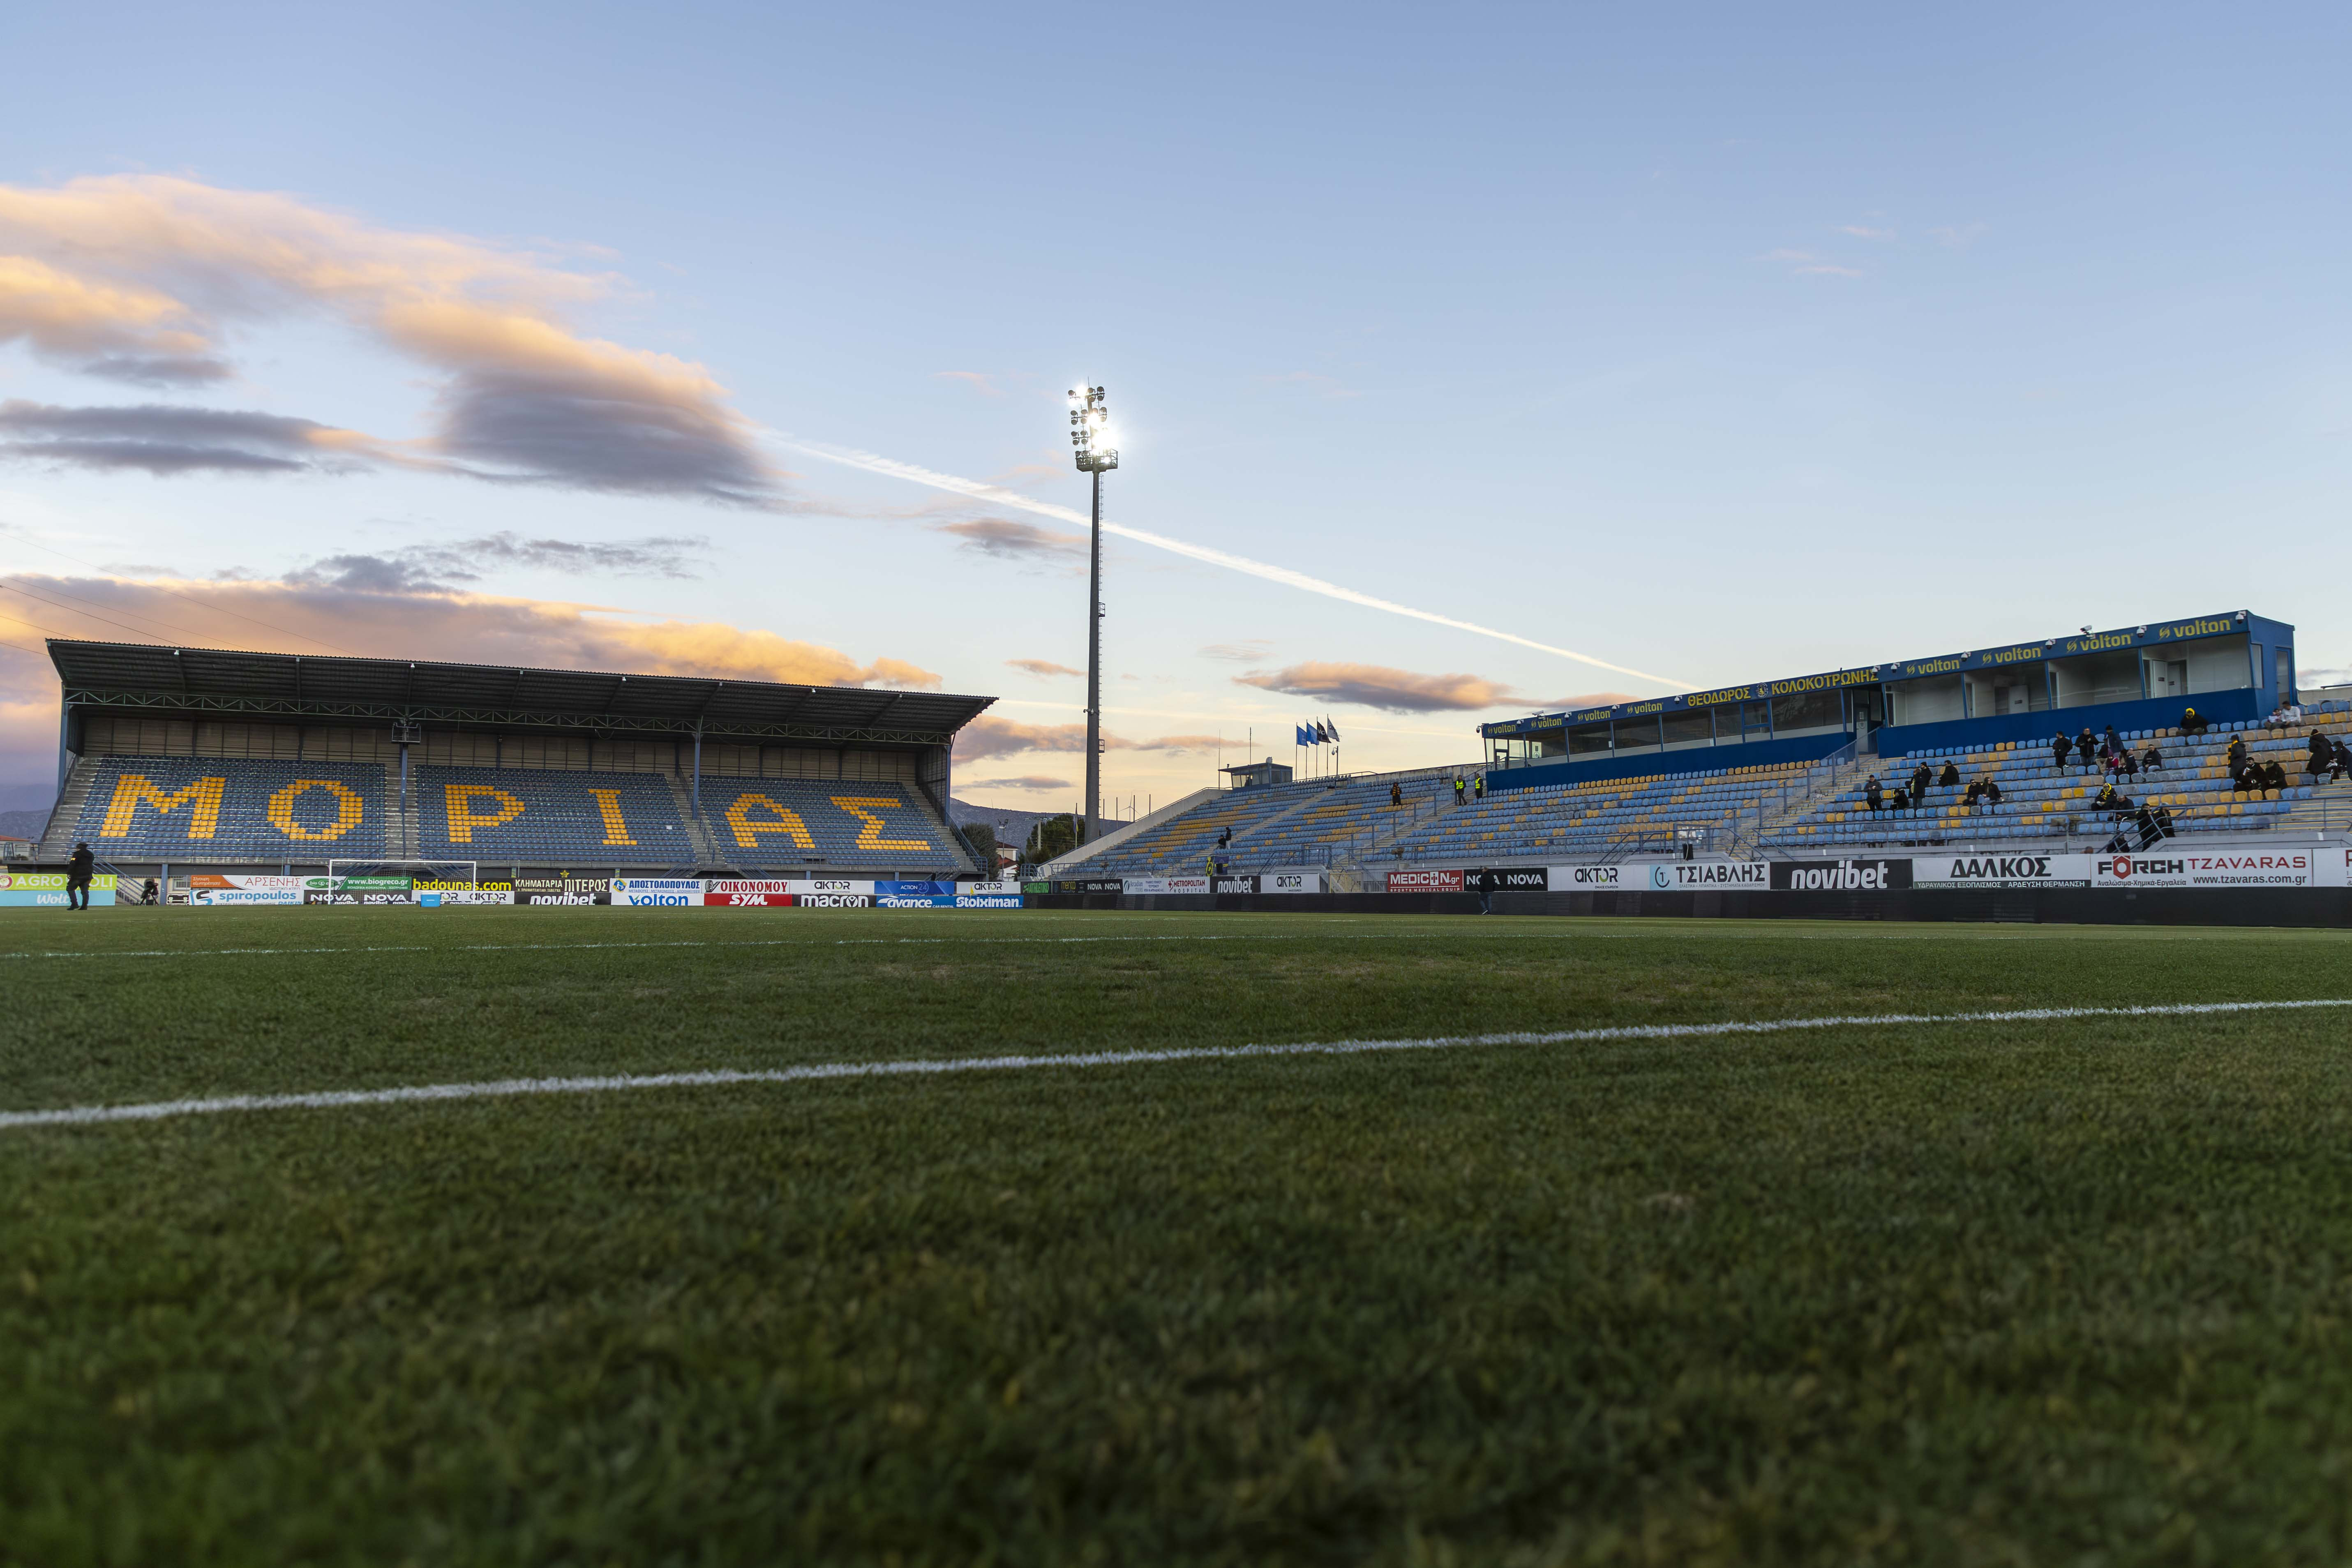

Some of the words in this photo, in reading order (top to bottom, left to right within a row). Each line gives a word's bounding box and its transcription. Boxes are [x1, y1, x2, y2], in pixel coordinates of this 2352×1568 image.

[2174, 619, 2231, 637] volton
[2080, 634, 2132, 651] volton
[1994, 647, 2041, 663] volton
[1918, 659, 1960, 674] volton
[1687, 687, 1751, 707] ΘΕΟΔΩΡΟΣ
[1771, 669, 1879, 695] ΚΟΛΟΚΟΤΡΩΝΗΣ
[1634, 702, 1662, 714] volton
[1584, 710, 1611, 721] volton
[1493, 724, 1516, 734] volton
[1537, 718, 1562, 728] volton
[1950, 857, 2052, 878] ΔΑΛΚΟΣ
[2188, 857, 2306, 869] TZAVARAS
[1507, 874, 1544, 884] NOVA
[1676, 864, 1765, 883] ΤΣΙΑΒΛΗΣ
[1791, 860, 1888, 889] novibet
[245, 877, 300, 887] ΑΡΣΕΝΗΣ
[413, 878, 511, 891] badounas.com
[515, 879, 563, 887] ΚΛΗΜΑΤΑΡΙΑ
[564, 879, 608, 891] ΠΙΤΕΡΟΣ
[629, 880, 700, 889] ΑΠΟΣΤΟΛΟΠΟΥΛΟΣ
[720, 881, 787, 892] ΟΙΚΟΝΟΜΟΥ
[1217, 876, 1252, 893] novibet
[2193, 875, 2306, 886] www.tzavaras.com.gr
[37, 893, 69, 904] Wolt
[219, 891, 296, 902] spiropoulos
[530, 892, 596, 905] novibet
[628, 894, 688, 905] volton
[729, 894, 768, 906] SYM
[801, 895, 868, 907] macron
[956, 896, 1019, 908] Stoiximan
[887, 899, 932, 908] avance
